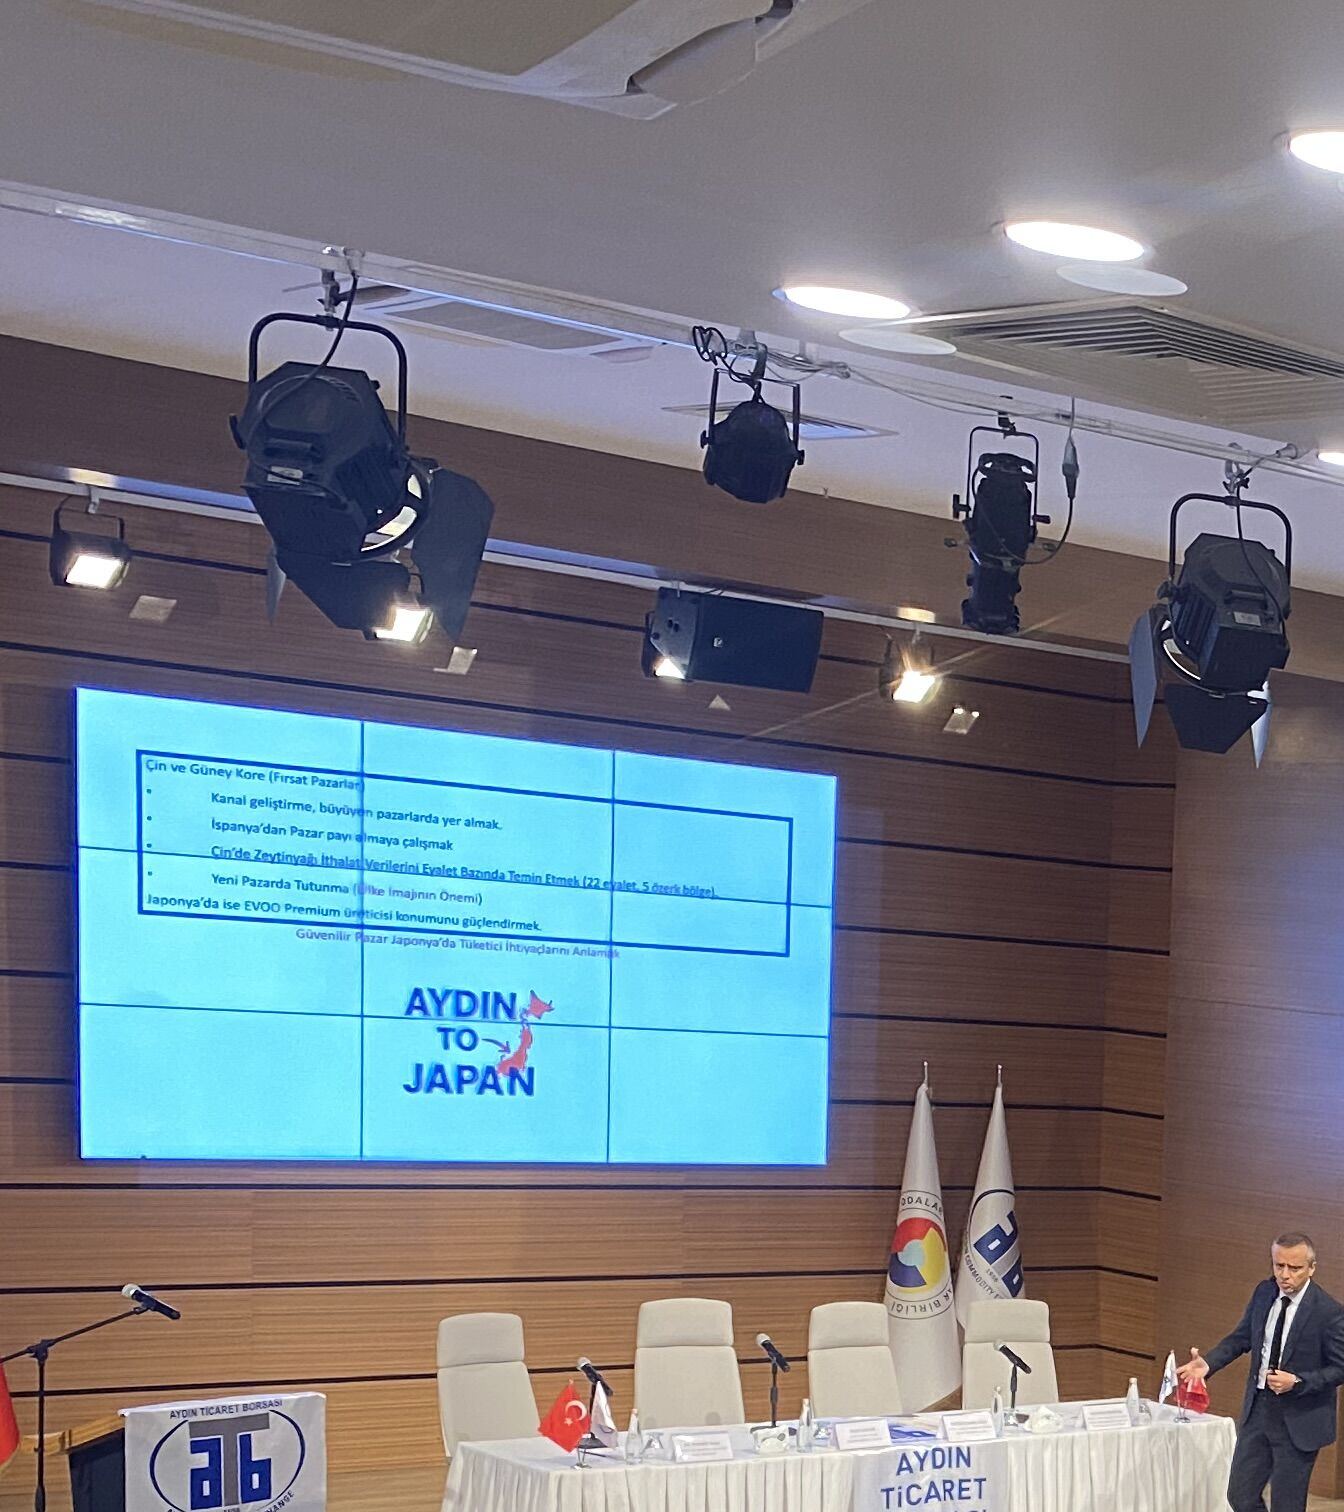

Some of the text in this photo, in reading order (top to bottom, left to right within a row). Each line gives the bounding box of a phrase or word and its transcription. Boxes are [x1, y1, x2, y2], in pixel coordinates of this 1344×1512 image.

[146, 759, 167, 772] Çin
[170, 763, 186, 773] ve
[190, 763, 232, 780] Güney
[235, 768, 265, 781] Kore
[211, 792, 247, 806] Kanal
[249, 796, 316, 813] geliştirme,
[377, 809, 439, 824] pazarlarda
[442, 816, 462, 828] yer
[290, 825, 324, 839] Pazar
[326, 830, 352, 843] payı
[355, 832, 400, 847] almaya
[402, 837, 454, 851] çalışmak
[211, 873, 238, 886] Yeni
[242, 875, 291, 890] Pazarda
[294, 879, 349, 894] Tutunma
[642, 881, 649, 892] 5
[147, 893, 219, 909] Japonya'da
[223, 899, 240, 910] ise
[244, 900, 281, 912] EVOO
[284, 903, 340, 917] Premium
[396, 910, 459, 925] konumunu
[296, 927, 351, 942] Güvenilir
[460, 938, 502, 952] Tüketici
[404, 987, 517, 1020] AYDIN
[437, 1026, 479, 1051] TO
[402, 1063, 535, 1096] JAPAN
[170, 1408, 198, 1420] AYDIN
[242, 1399, 283, 1412] BORSASI
[896, 1446, 971, 1476] AYDIN
